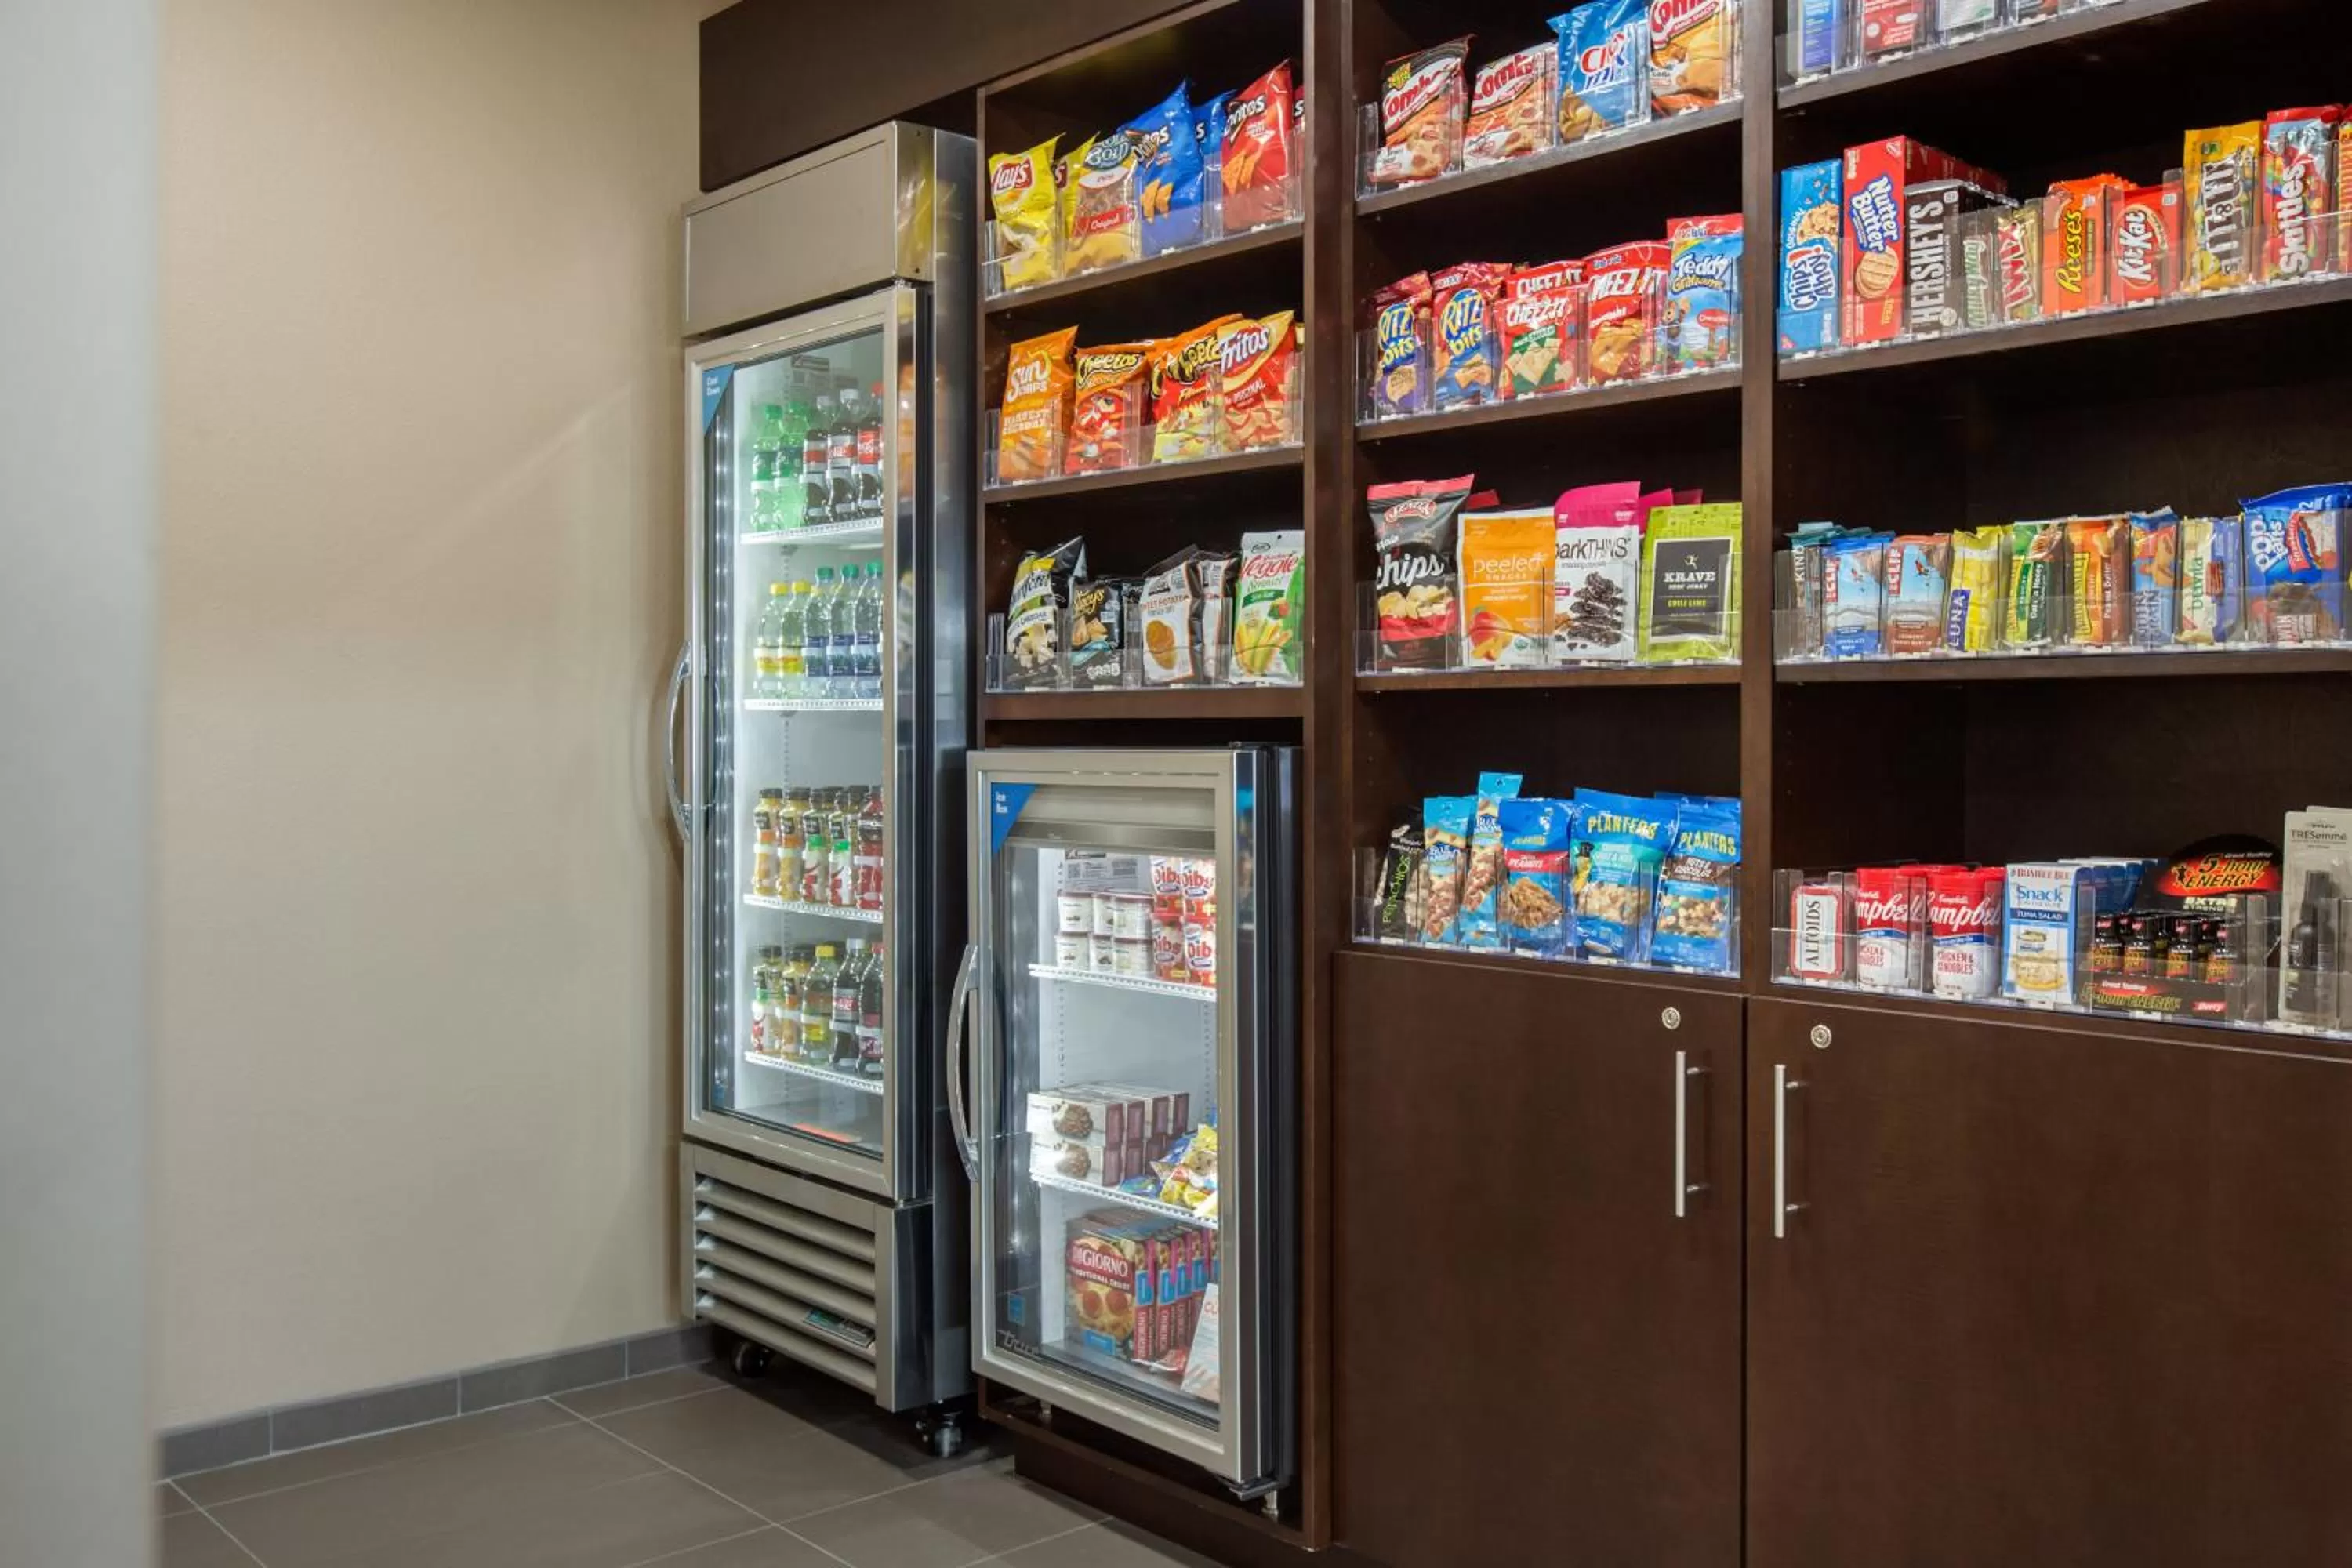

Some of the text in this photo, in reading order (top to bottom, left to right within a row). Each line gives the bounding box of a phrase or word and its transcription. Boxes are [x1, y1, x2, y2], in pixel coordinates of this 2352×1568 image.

[993, 158, 1030, 191] Lay's
[1852, 191, 1883, 252] Butter
[1869, 176, 1898, 241] Nutter
[2278, 163, 2309, 274] Skittles
[1674, 252, 1730, 280] Teddy
[1909, 200, 1945, 324] HERSHEY'S
[1998, 221, 2033, 307] TWIX
[1791, 260, 1819, 310] Chips
[1379, 307, 1414, 343] RITZ
[1441, 293, 1484, 340] RITZ
[1218, 328, 1269, 373] Fritos
[1006, 350, 1051, 402] Sun
[1076, 353, 1142, 390] Cheetos
[1242, 554, 1298, 578] Veggie
[1474, 552, 1542, 579] peeled
[1664, 572, 1715, 582] KRAVE
[1948, 596, 1965, 648] LUNA
[1588, 814, 1659, 840] PLANTERS
[2016, 884, 2063, 902] Snack
[2185, 872, 2263, 888] ENERGY
[2017, 910, 2063, 920] TUNA SALAD
[1187, 942, 1212, 958] Dib
[1806, 900, 1820, 967] ALTOIDS
[2196, 1001, 2225, 1012] Berry
